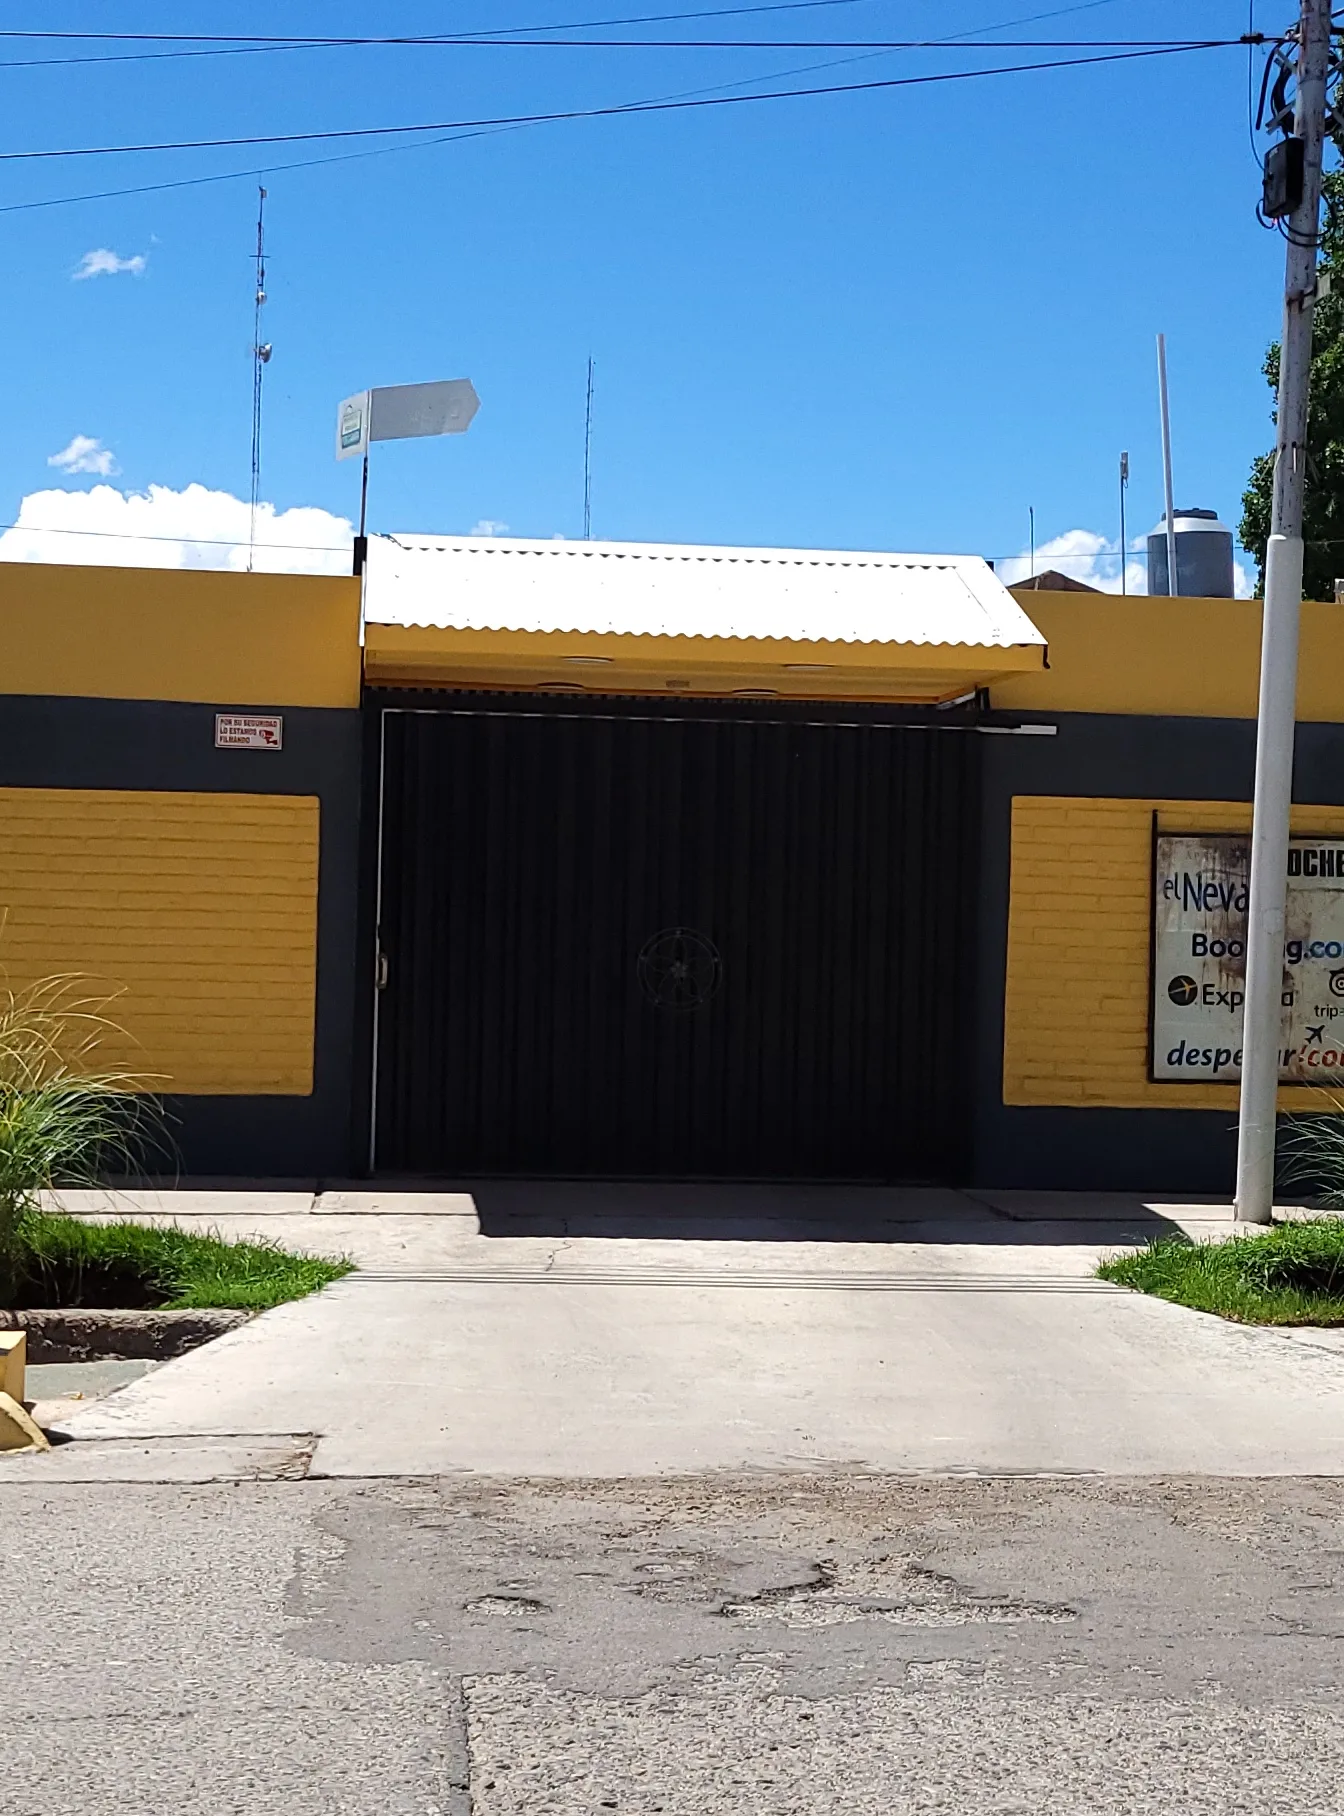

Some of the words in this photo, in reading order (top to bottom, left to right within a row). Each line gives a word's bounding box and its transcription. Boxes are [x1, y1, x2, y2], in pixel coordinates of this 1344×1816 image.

[229, 728, 257, 736] ESTAMOS
[1183, 872, 1249, 913] Neva
[1202, 983, 1294, 1014] Expa
